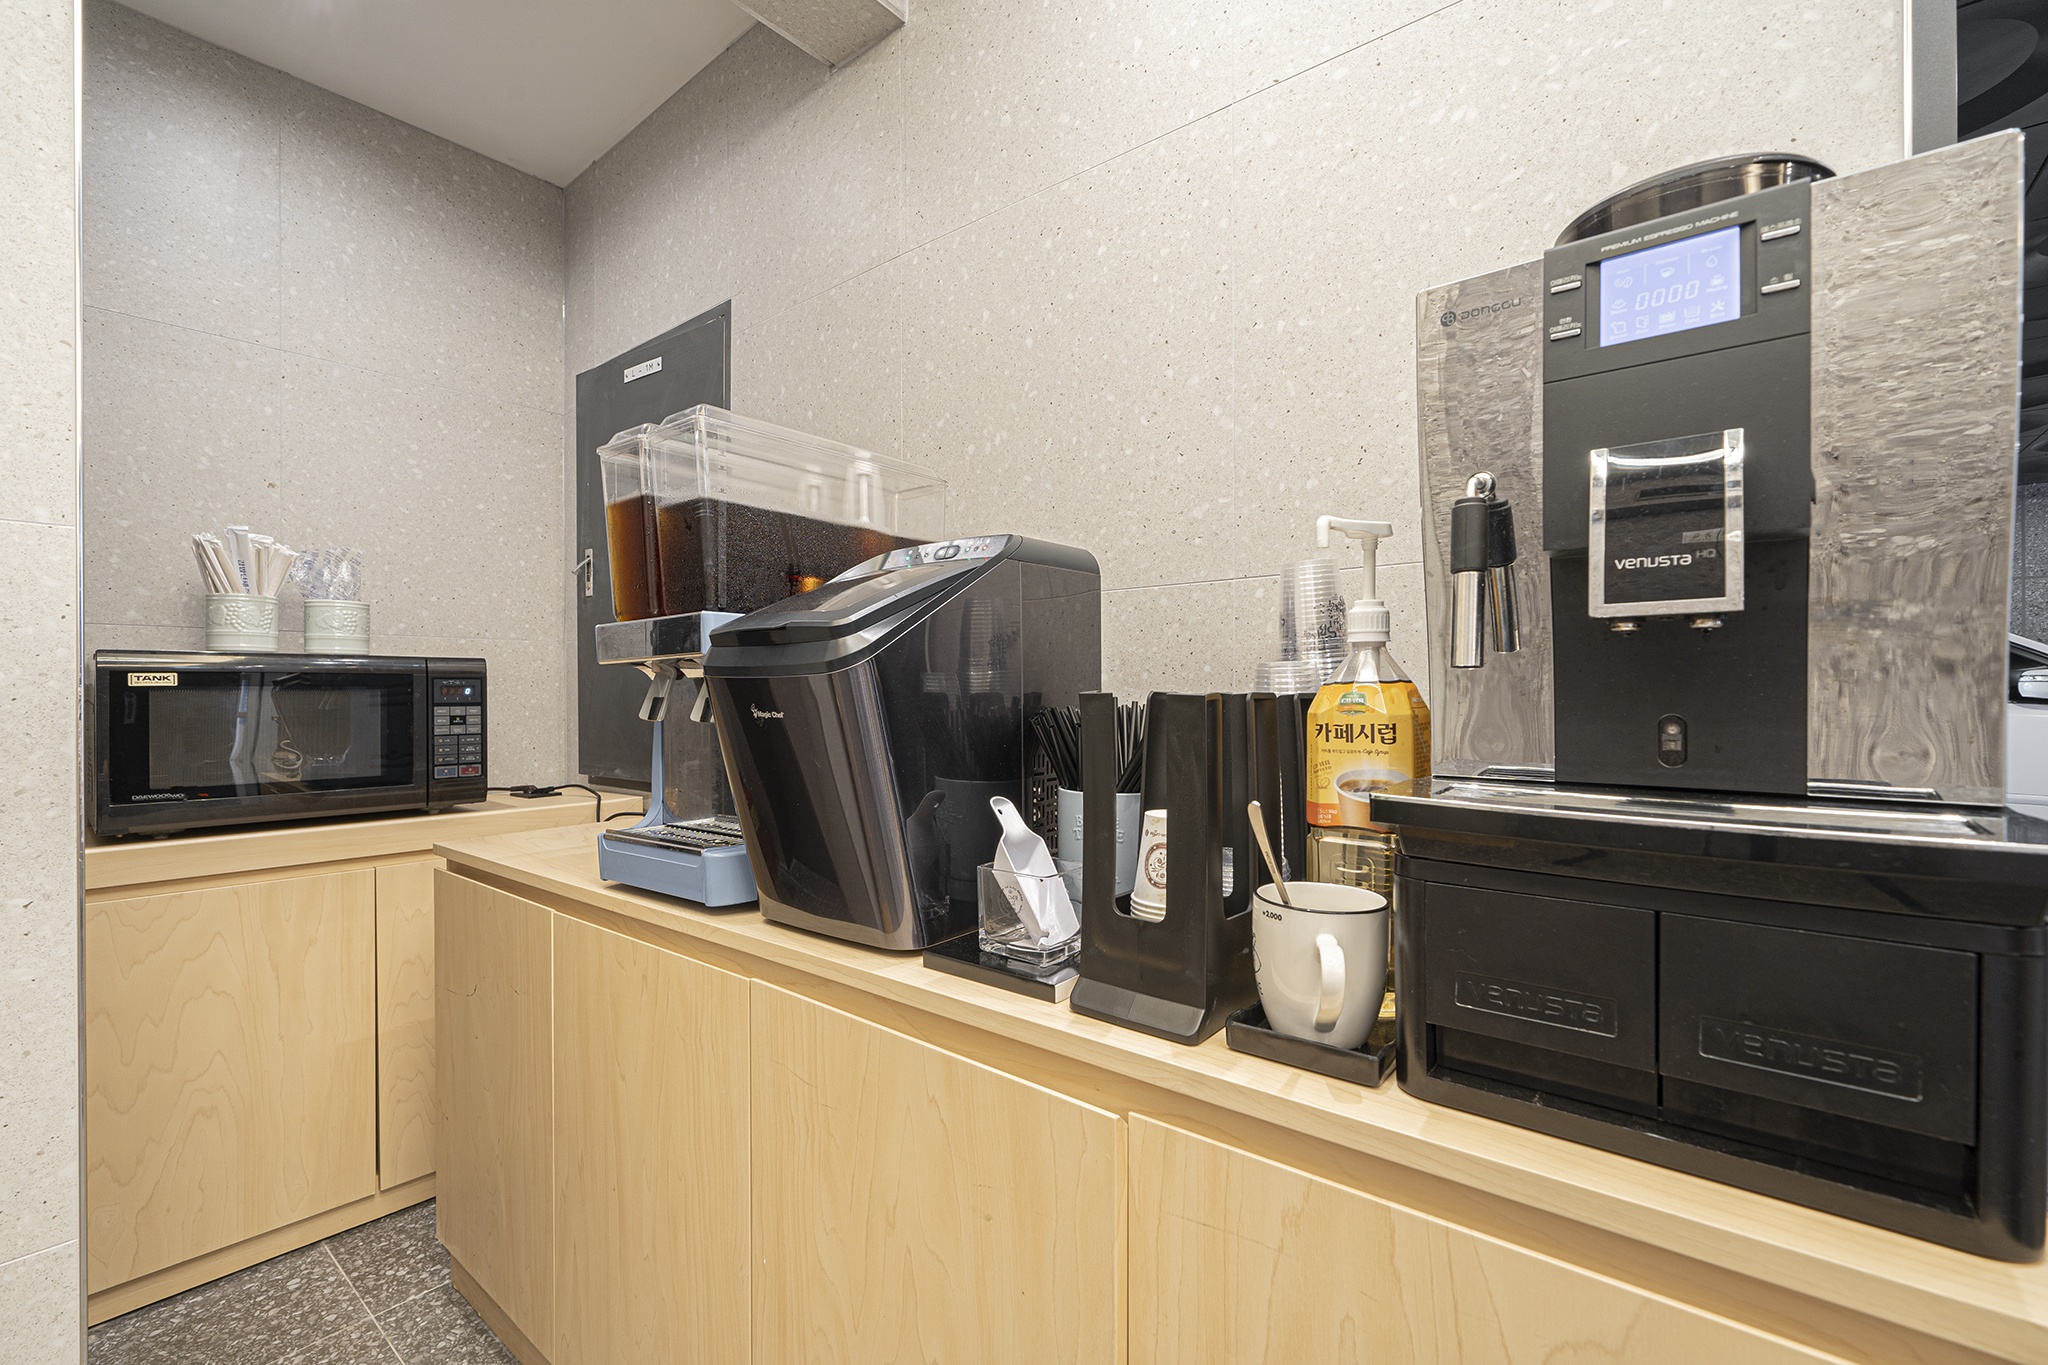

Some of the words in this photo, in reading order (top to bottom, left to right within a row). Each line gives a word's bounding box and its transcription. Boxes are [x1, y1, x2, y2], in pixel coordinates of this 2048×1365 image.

[1601, 237, 1642, 253] PREMIUM
[1644, 223, 1693, 242] ESPRESSO
[1695, 210, 1739, 228] MACHINE
[1635, 280, 1700, 311] 0000
[1696, 548, 1716, 559] HQ
[1315, 722, 1397, 745] 카페시럽
